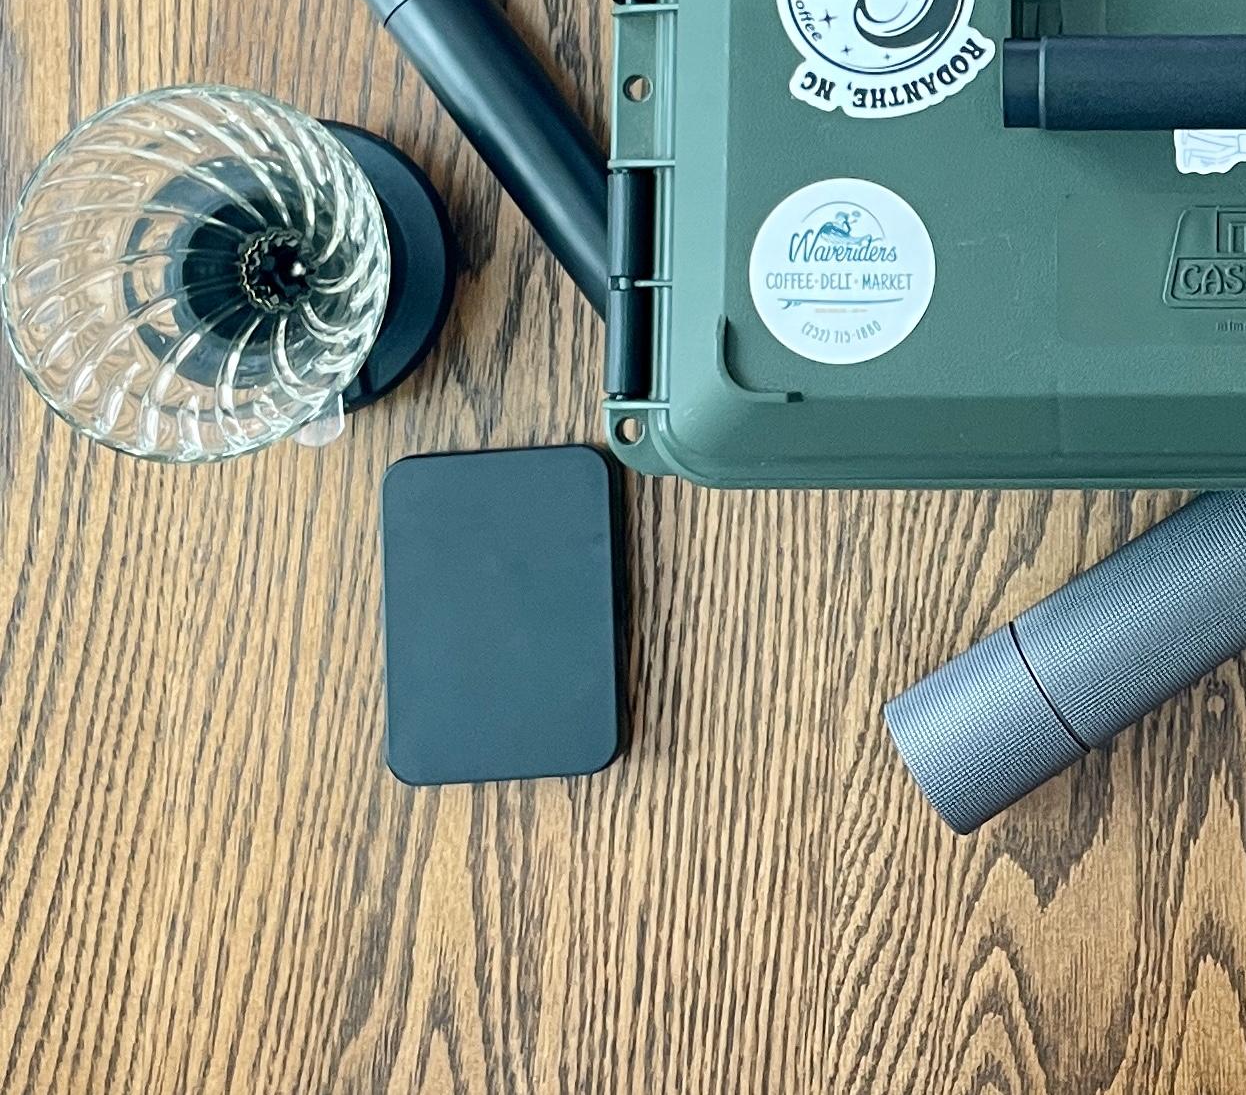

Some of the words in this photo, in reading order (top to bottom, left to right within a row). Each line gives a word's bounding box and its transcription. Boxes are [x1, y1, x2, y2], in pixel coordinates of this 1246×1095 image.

[800, 71, 836, 102] NC
[847, 38, 987, 109] RODANTHE,
[789, 227, 897, 263] Waveriders
[766, 272, 815, 290] COFFEE
[820, 273, 852, 290] DELI
[862, 273, 913, 290] MARKET
